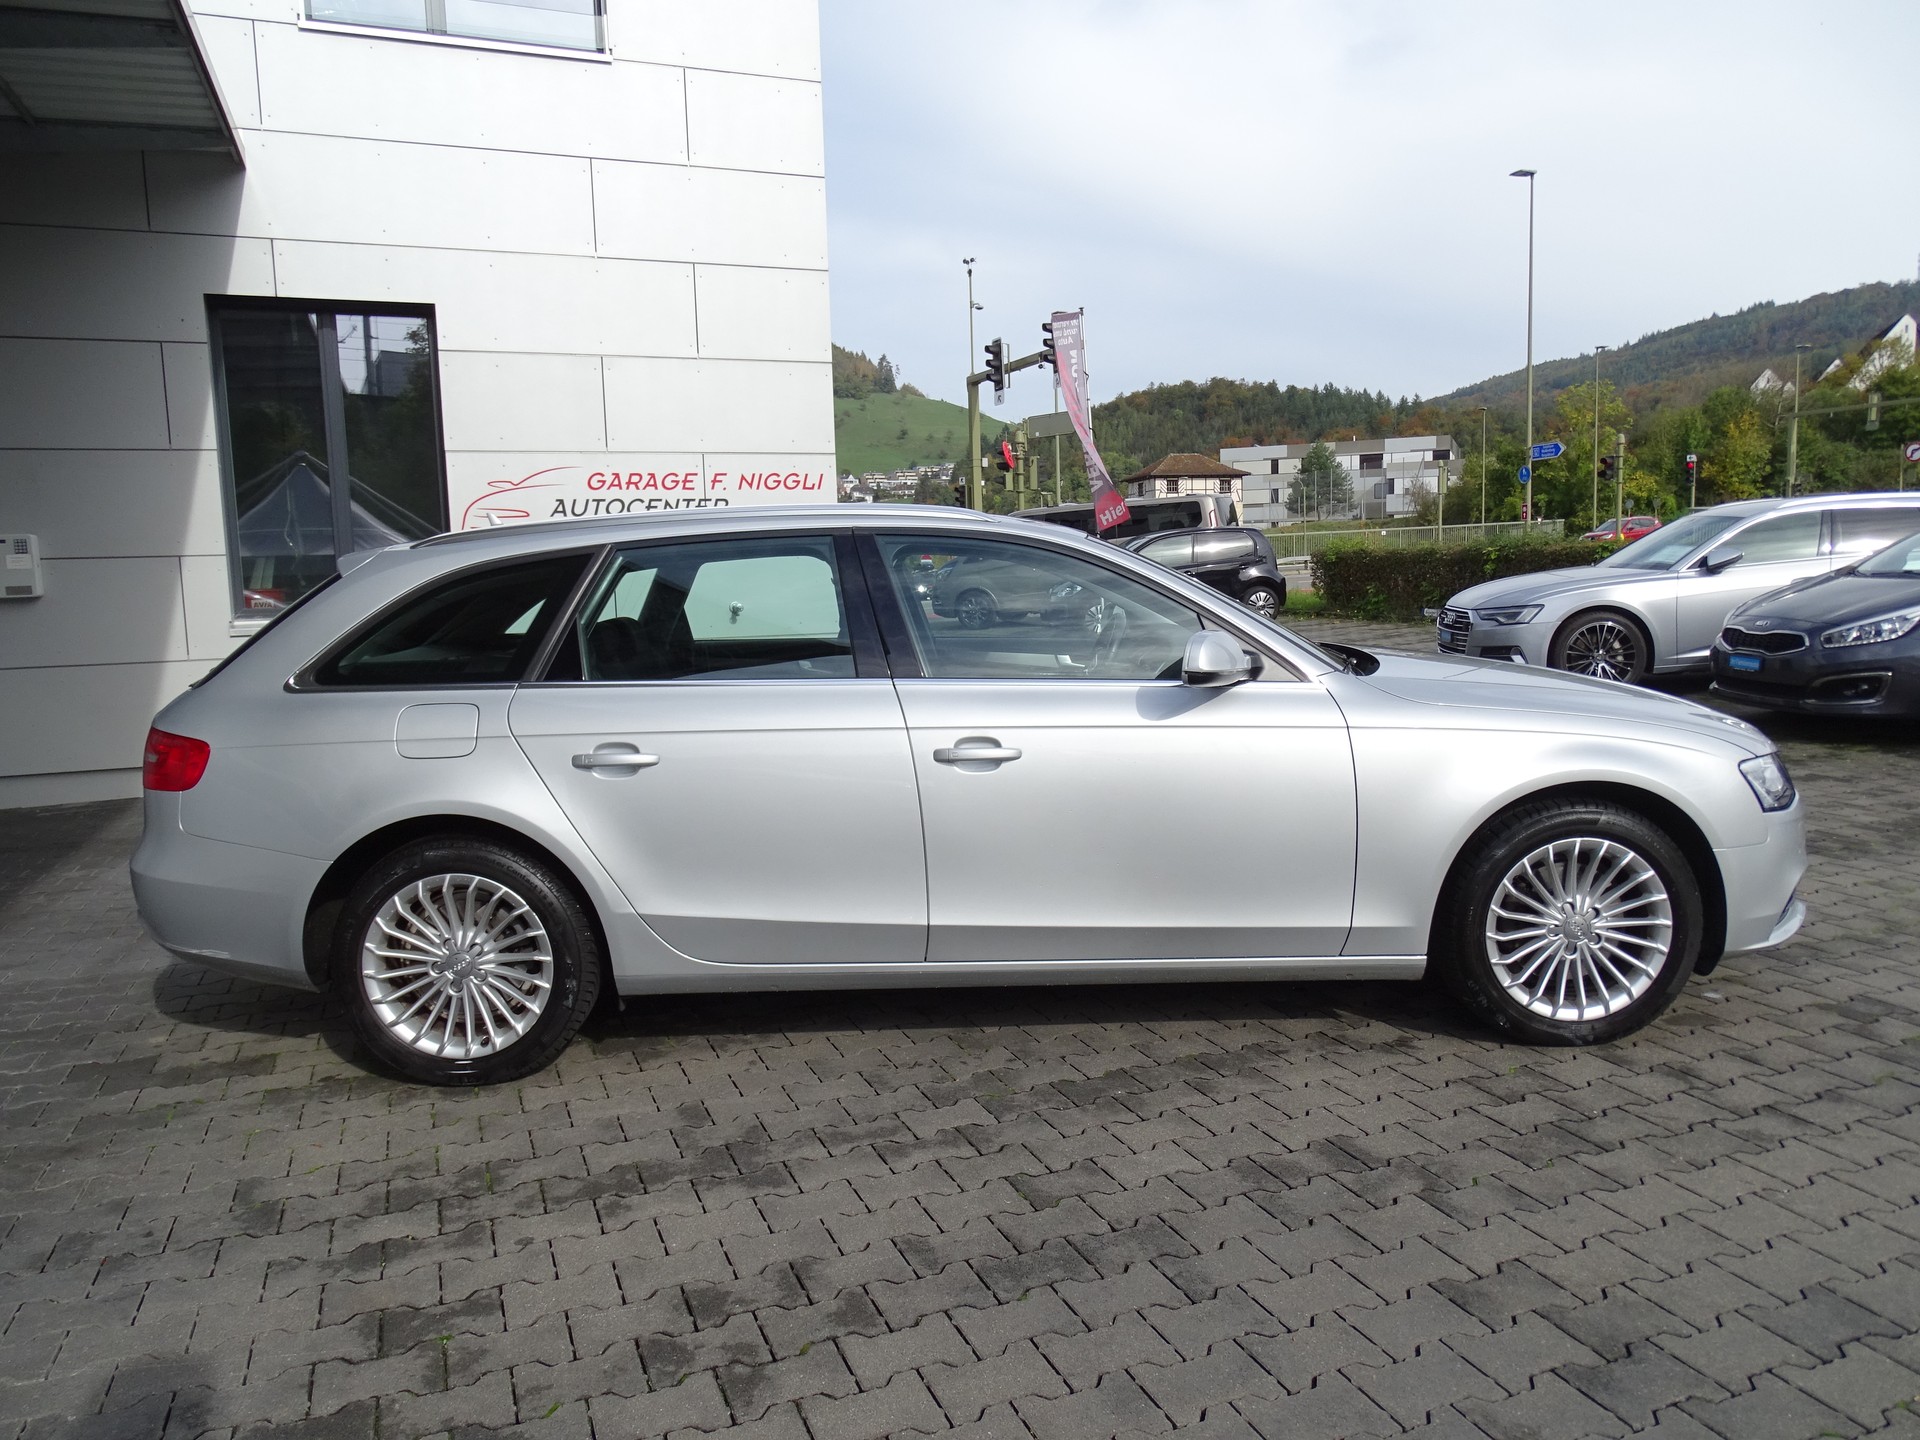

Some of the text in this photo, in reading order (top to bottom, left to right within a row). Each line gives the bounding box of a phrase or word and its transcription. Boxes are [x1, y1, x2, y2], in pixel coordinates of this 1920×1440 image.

[587, 472, 824, 491] GARAGE F. NIGGLI
